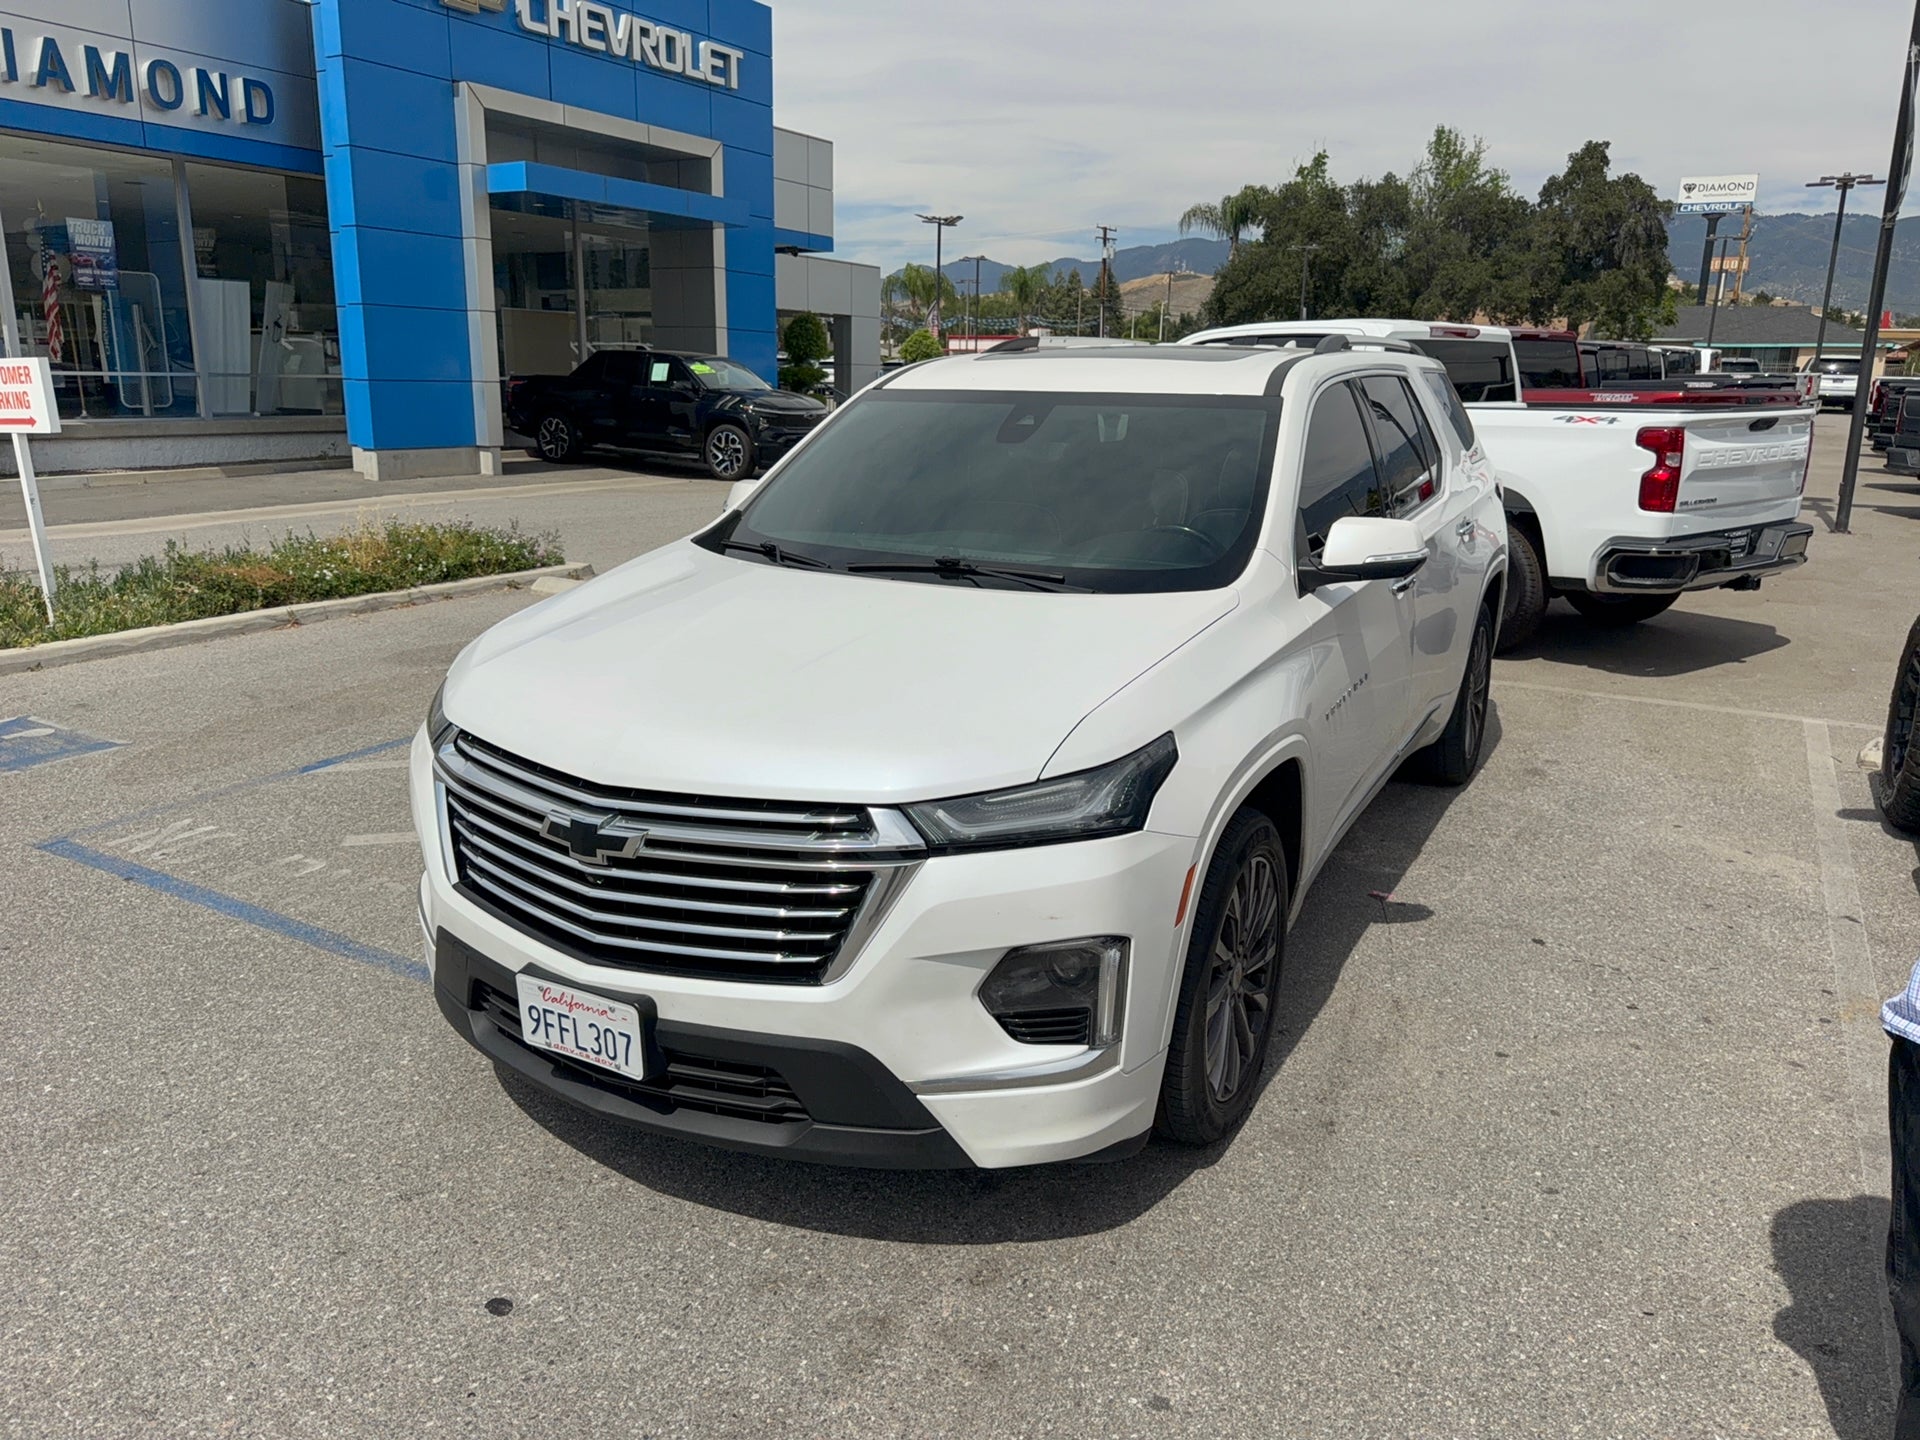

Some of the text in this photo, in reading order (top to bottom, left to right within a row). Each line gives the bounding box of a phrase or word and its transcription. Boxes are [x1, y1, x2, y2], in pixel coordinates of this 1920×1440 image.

[516, 0, 744, 89] CHEVROLET
[1, 27, 276, 125] IAMOND
[1698, 182, 1755, 192] DIAMOND
[69, 221, 106, 236] TRUCK
[74, 233, 113, 248] MONTH
[1697, 441, 1808, 467] CHEVROLET
[541, 986, 617, 1022] California
[528, 1005, 632, 1067] 9FFL307
